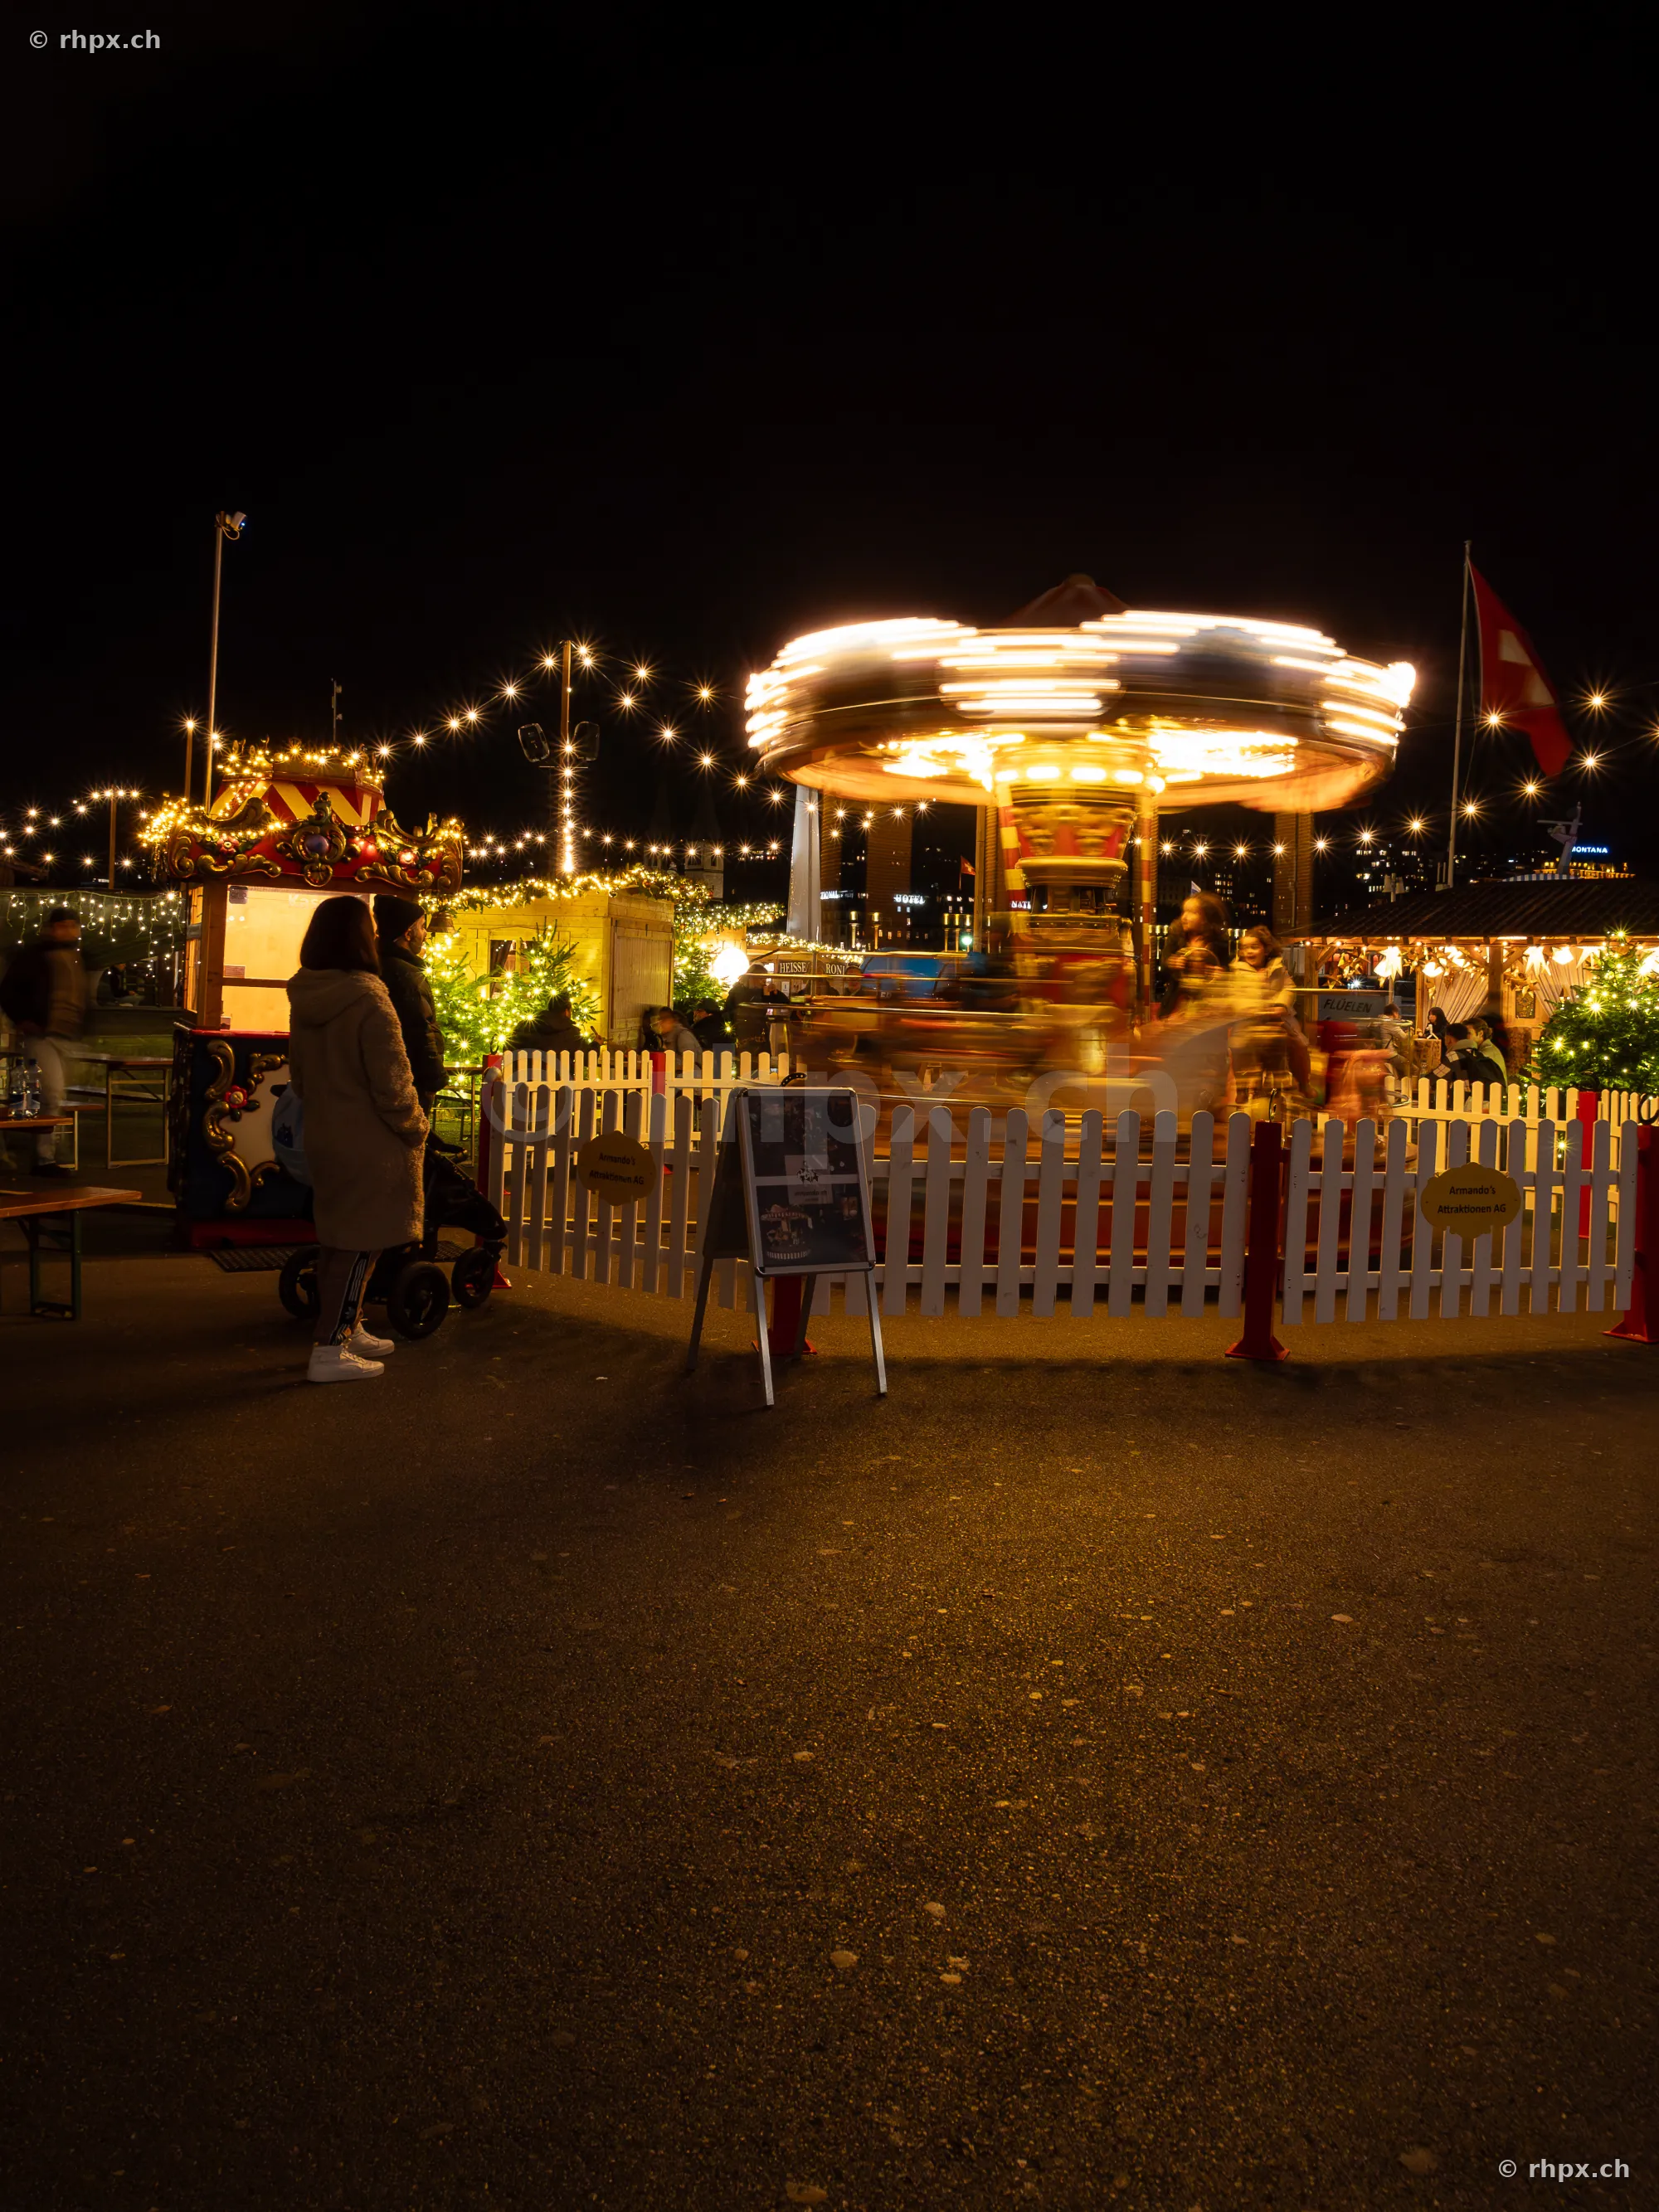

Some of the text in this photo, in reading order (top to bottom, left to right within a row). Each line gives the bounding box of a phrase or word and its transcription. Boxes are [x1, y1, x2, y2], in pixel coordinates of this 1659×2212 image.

[288, 893, 324, 910] Kas
[894, 894, 925, 904] HOTEL
[780, 961, 807, 974] HEISSE
[1323, 998, 1373, 1013] FLÜELEN
[598, 1152, 636, 1166] Armando's
[589, 1169, 645, 1185] Attraktionen AG
[1449, 1185, 1496, 1195] Armando's
[1438, 1203, 1506, 1214] Attraktionen AG
